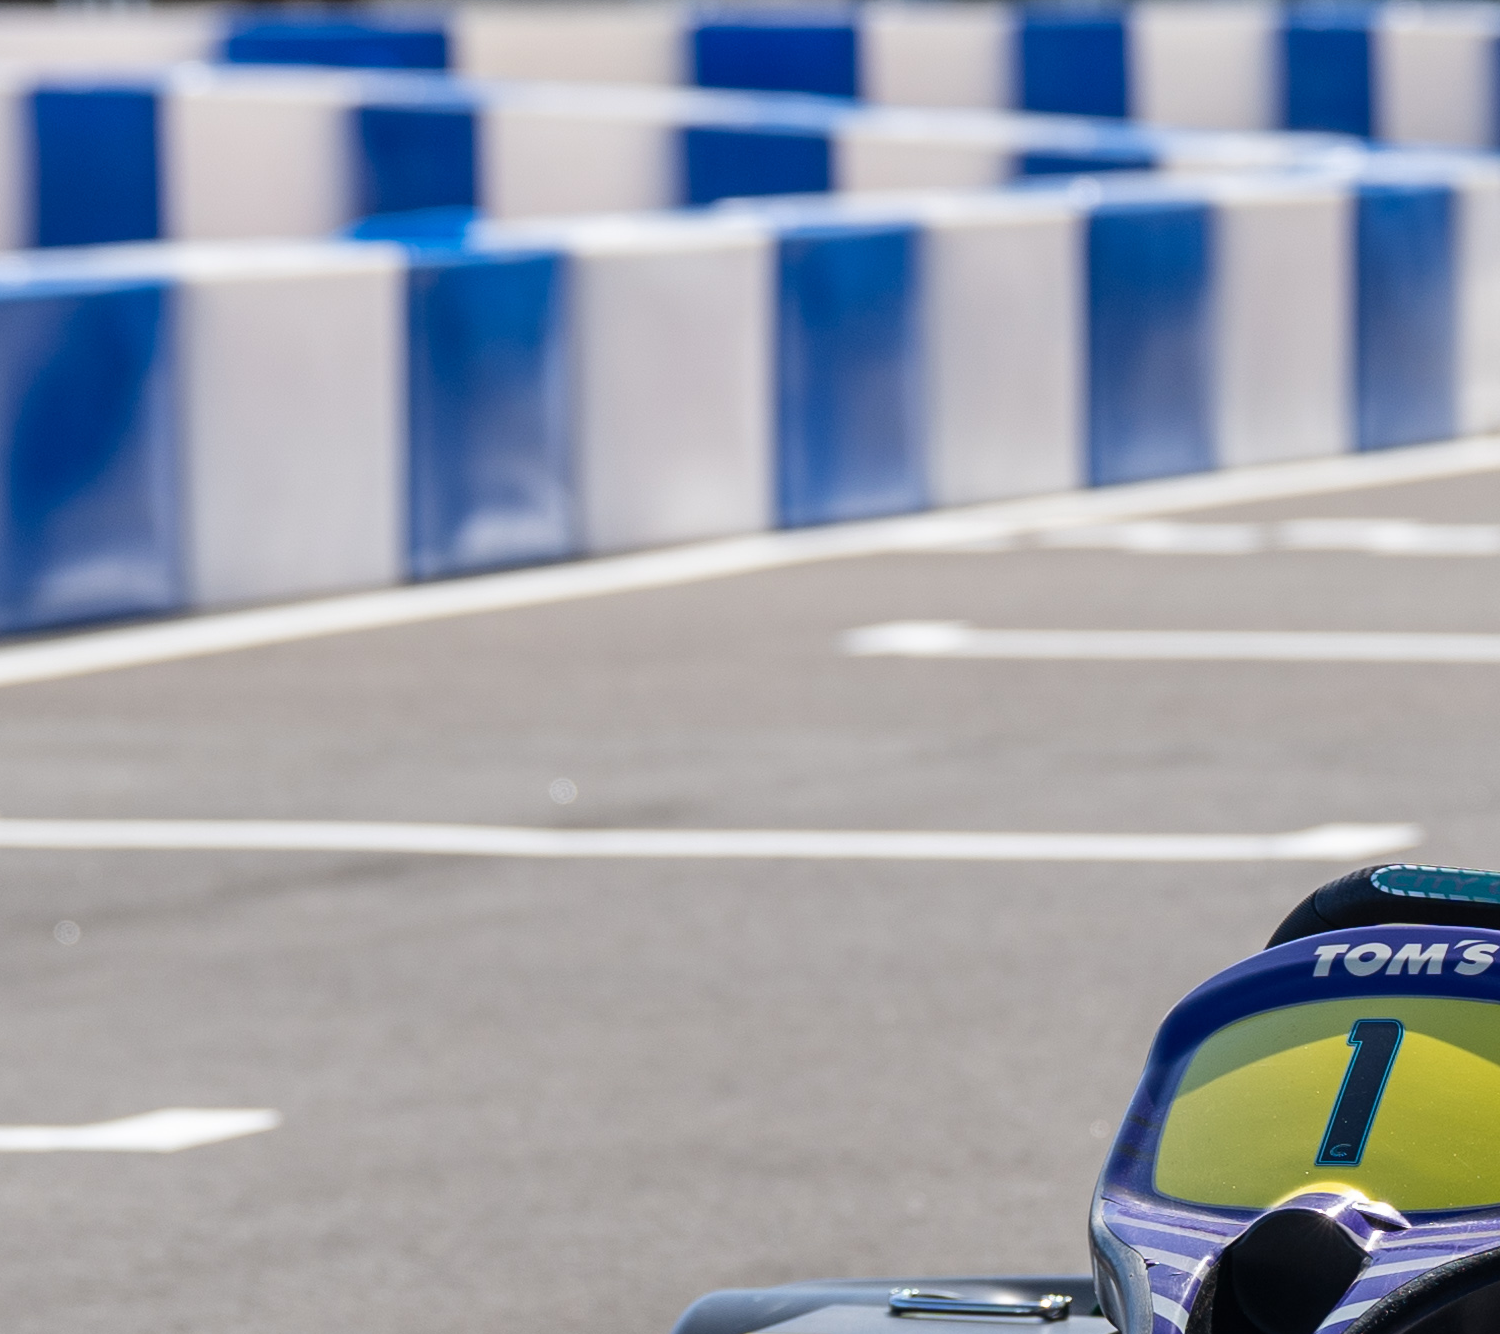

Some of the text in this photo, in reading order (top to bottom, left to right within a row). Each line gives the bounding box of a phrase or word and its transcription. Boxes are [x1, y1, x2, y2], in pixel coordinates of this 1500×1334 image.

[1387, 871, 1480, 892] CITY
[1313, 940, 1500, 977] TOM'S
[1314, 1019, 1405, 1166] 1
